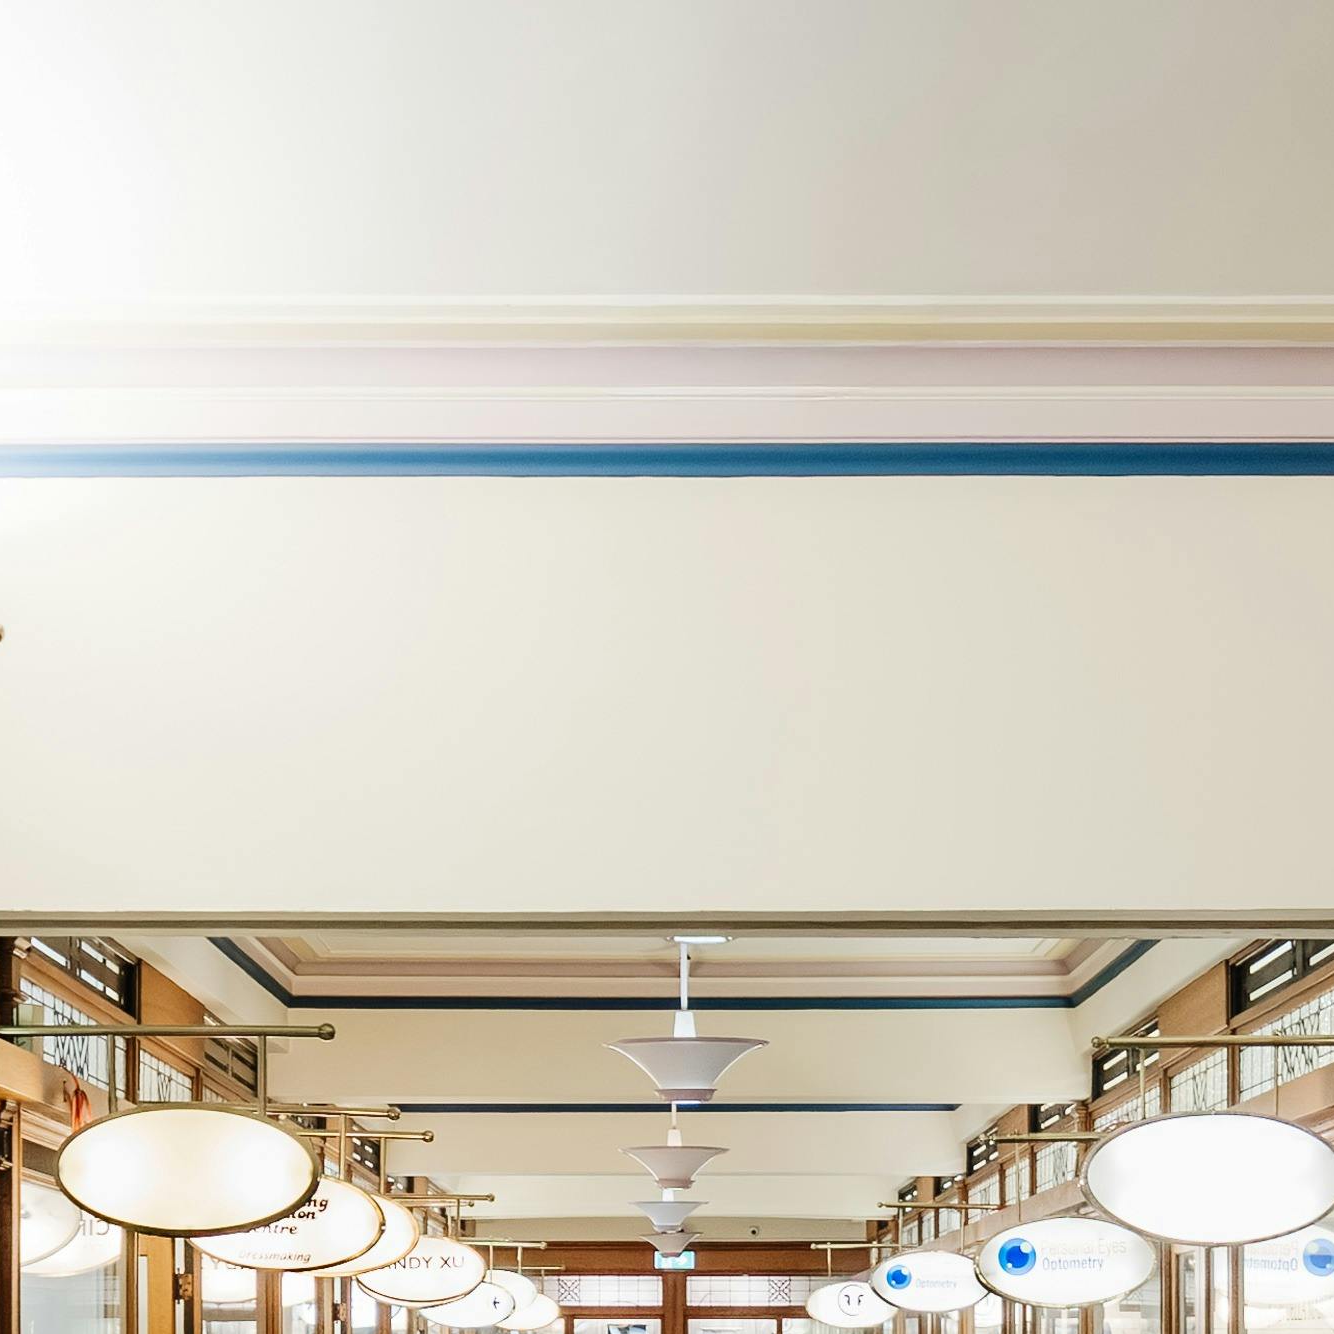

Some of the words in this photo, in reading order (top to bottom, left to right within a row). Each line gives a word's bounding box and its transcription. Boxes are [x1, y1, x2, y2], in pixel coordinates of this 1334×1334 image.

[238, 1250, 311, 1264] Dressmaking
[440, 1256, 464, 1269] XU
[1042, 1257, 1104, 1271] Optometry
